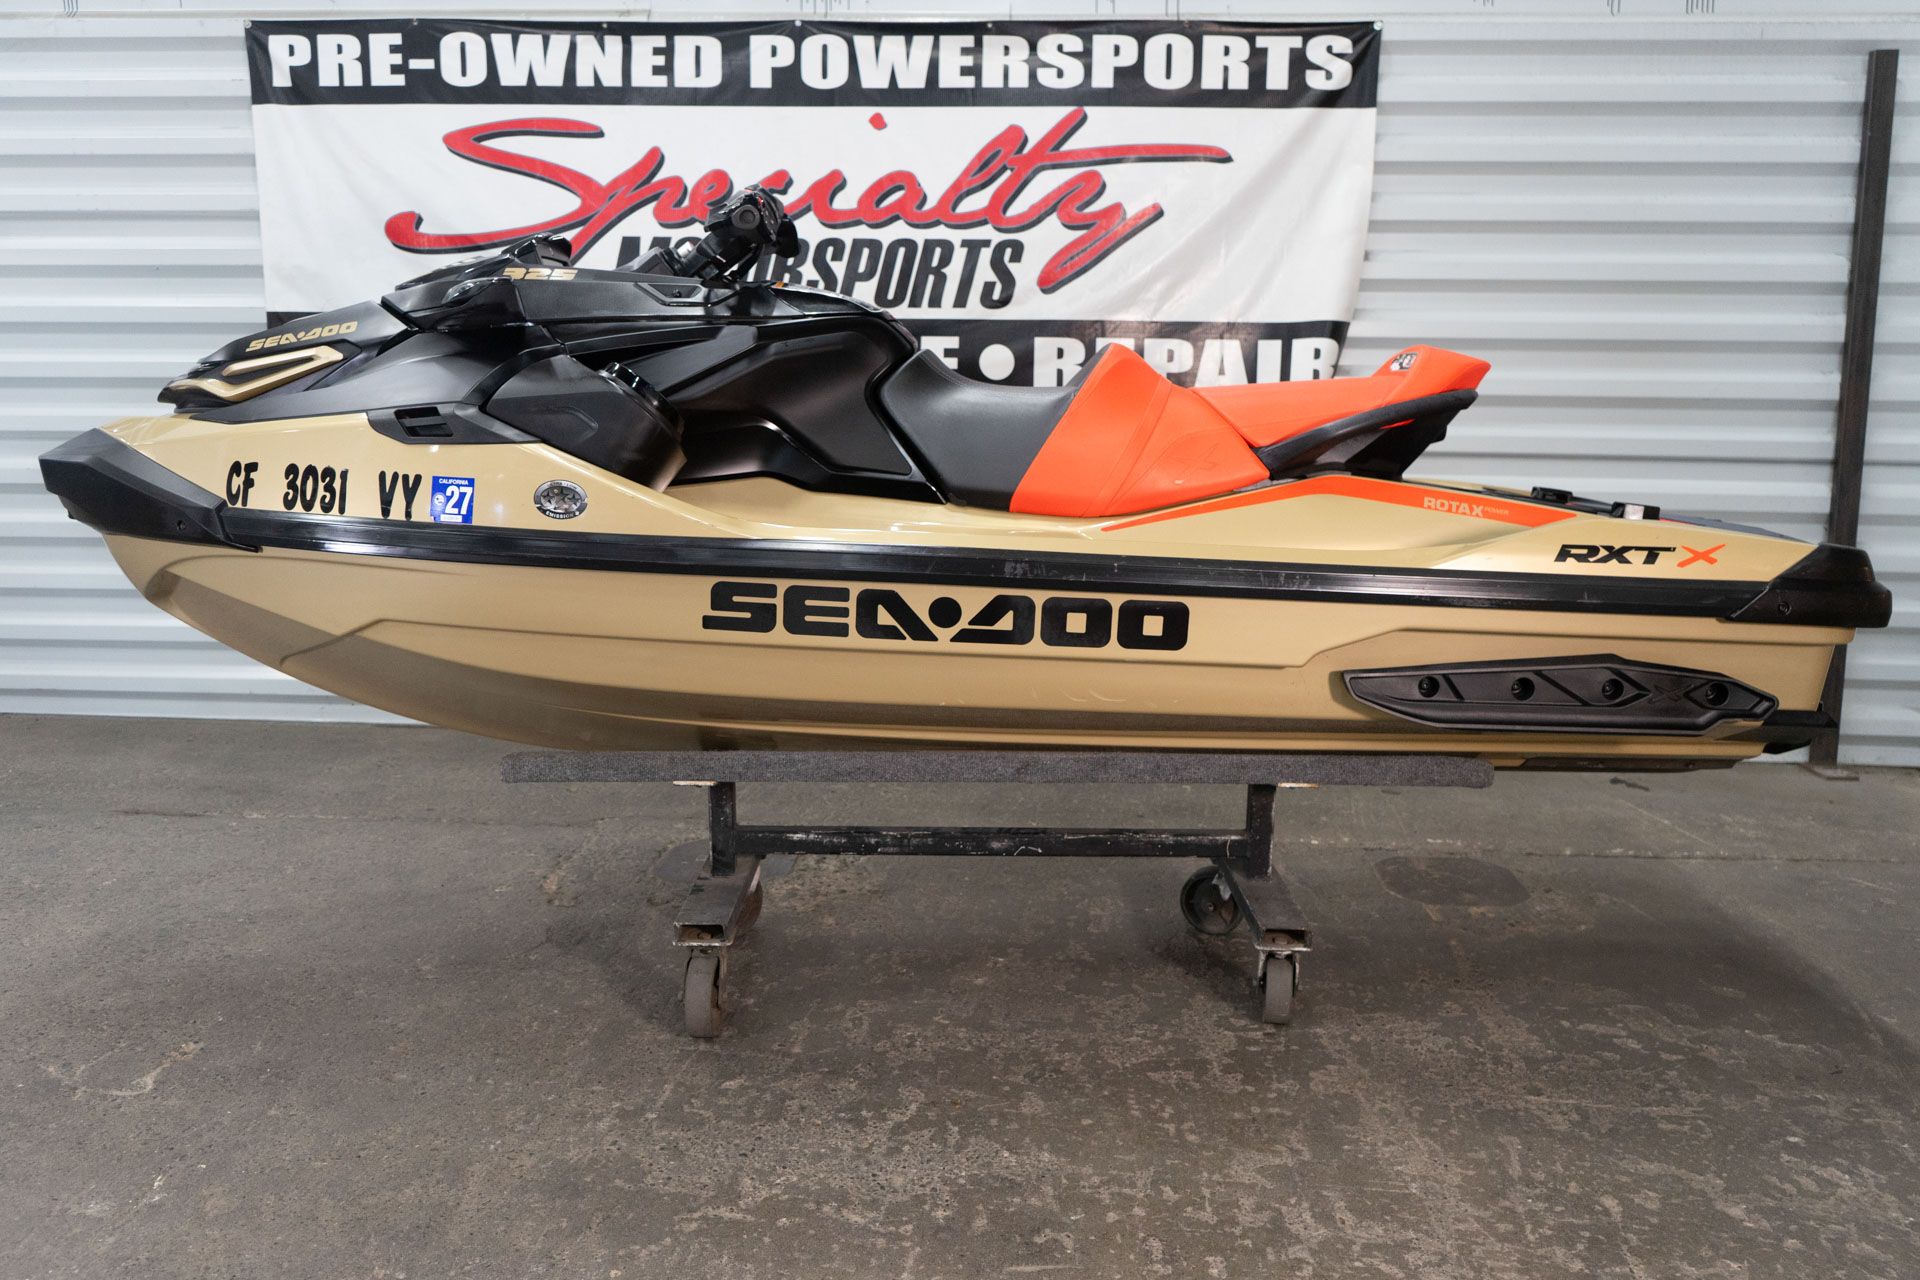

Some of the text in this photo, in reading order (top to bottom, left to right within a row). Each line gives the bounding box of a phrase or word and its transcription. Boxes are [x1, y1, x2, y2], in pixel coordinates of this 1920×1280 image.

[268, 32, 1354, 91] PRE-OWNED POWERSPORTS
[502, 267, 579, 281] 325
[616, 236, 1025, 310] MRSPORTS
[226, 460, 423, 521] CF 3031 VY
[438, 478, 469, 486] CALIFORNIA
[445, 485, 473, 515] 27
[1423, 496, 1484, 517] ROTAX
